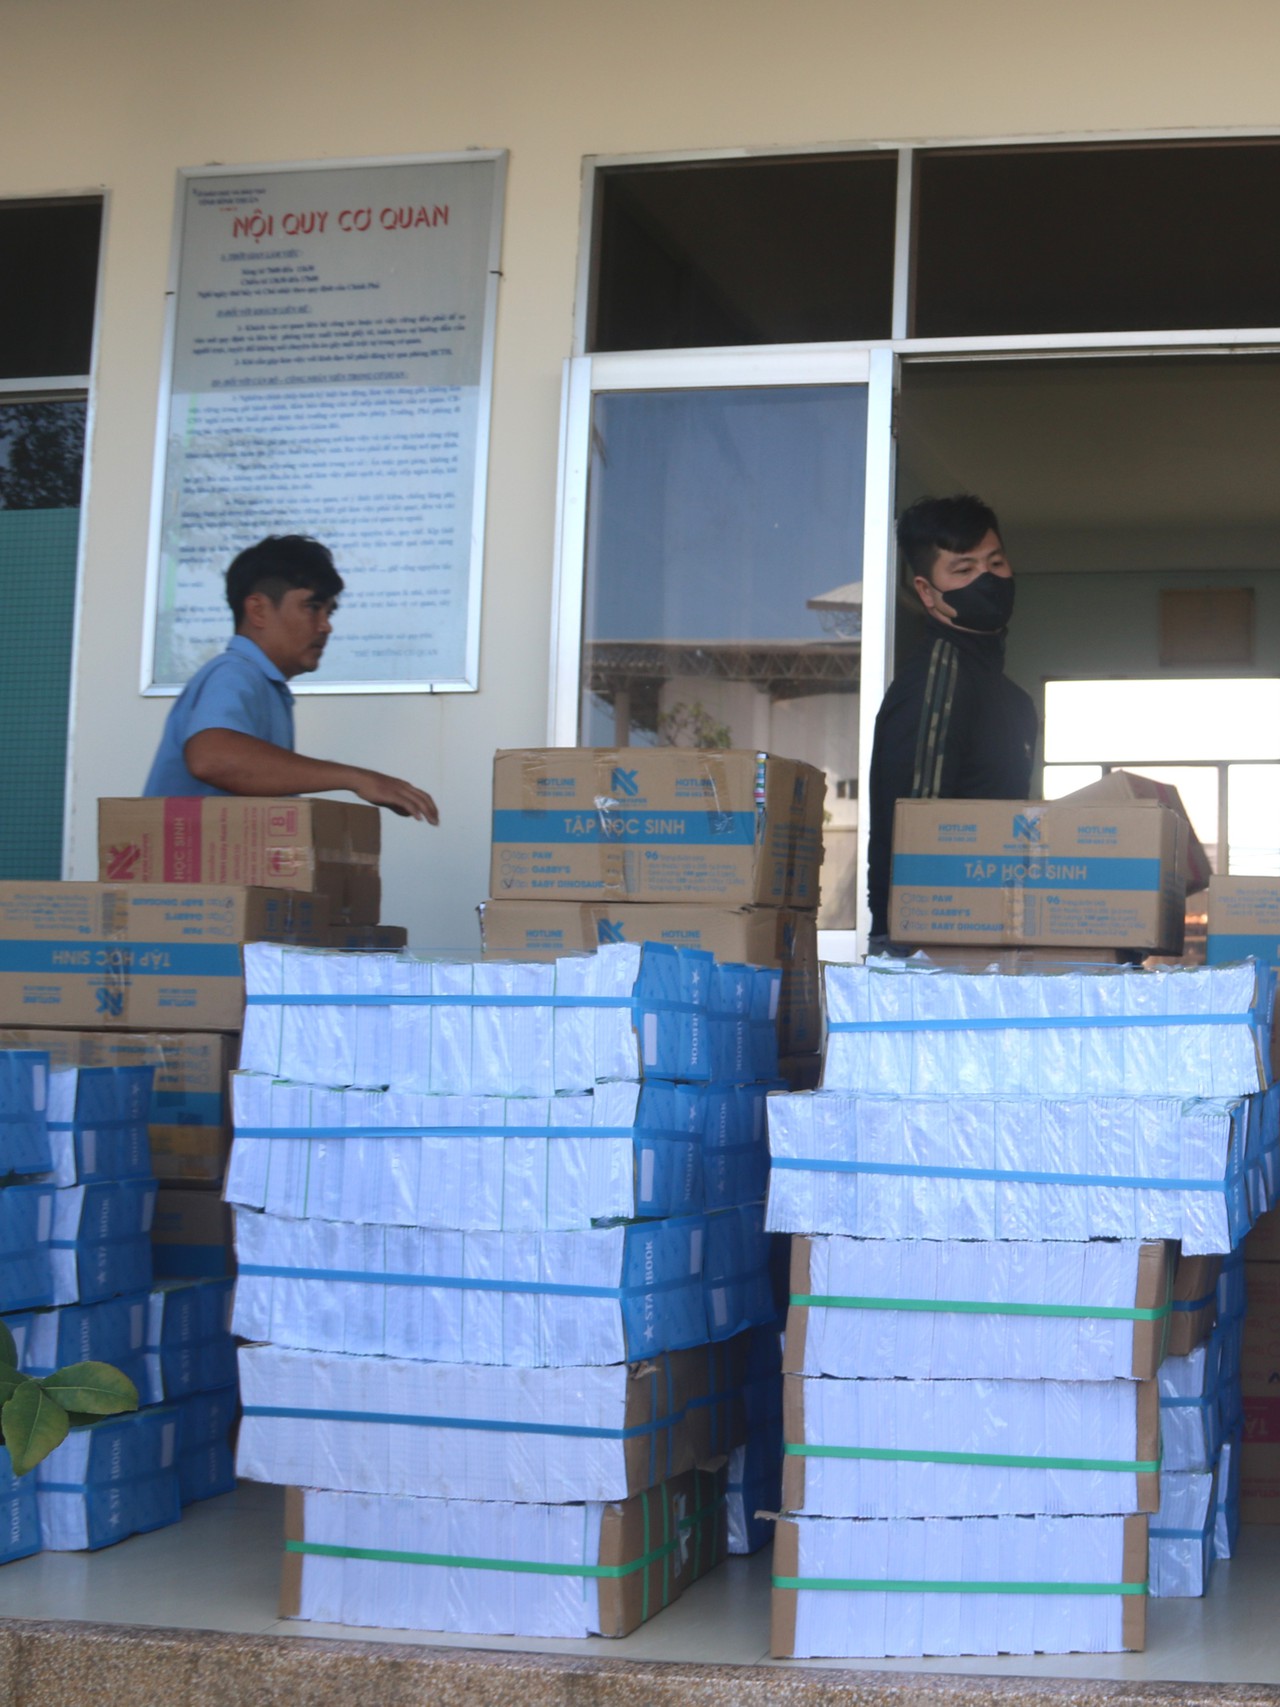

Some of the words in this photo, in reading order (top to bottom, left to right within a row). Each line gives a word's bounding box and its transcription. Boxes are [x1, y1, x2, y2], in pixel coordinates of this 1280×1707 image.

[233, 209, 274, 243] NỘI
[282, 210, 329, 236] QUY
[338, 208, 373, 232] CƠ
[380, 204, 450, 231] QUAN
[174, 817, 185, 847] SINH
[564, 817, 595, 838] TẬP
[645, 819, 685, 834] SINH
[965, 861, 996, 881] TẬP
[1003, 864, 1040, 882] HỌC
[1049, 865, 1087, 880] SINH
[52, 951, 91, 965] SINH
[141, 949, 172, 968] TẬP
